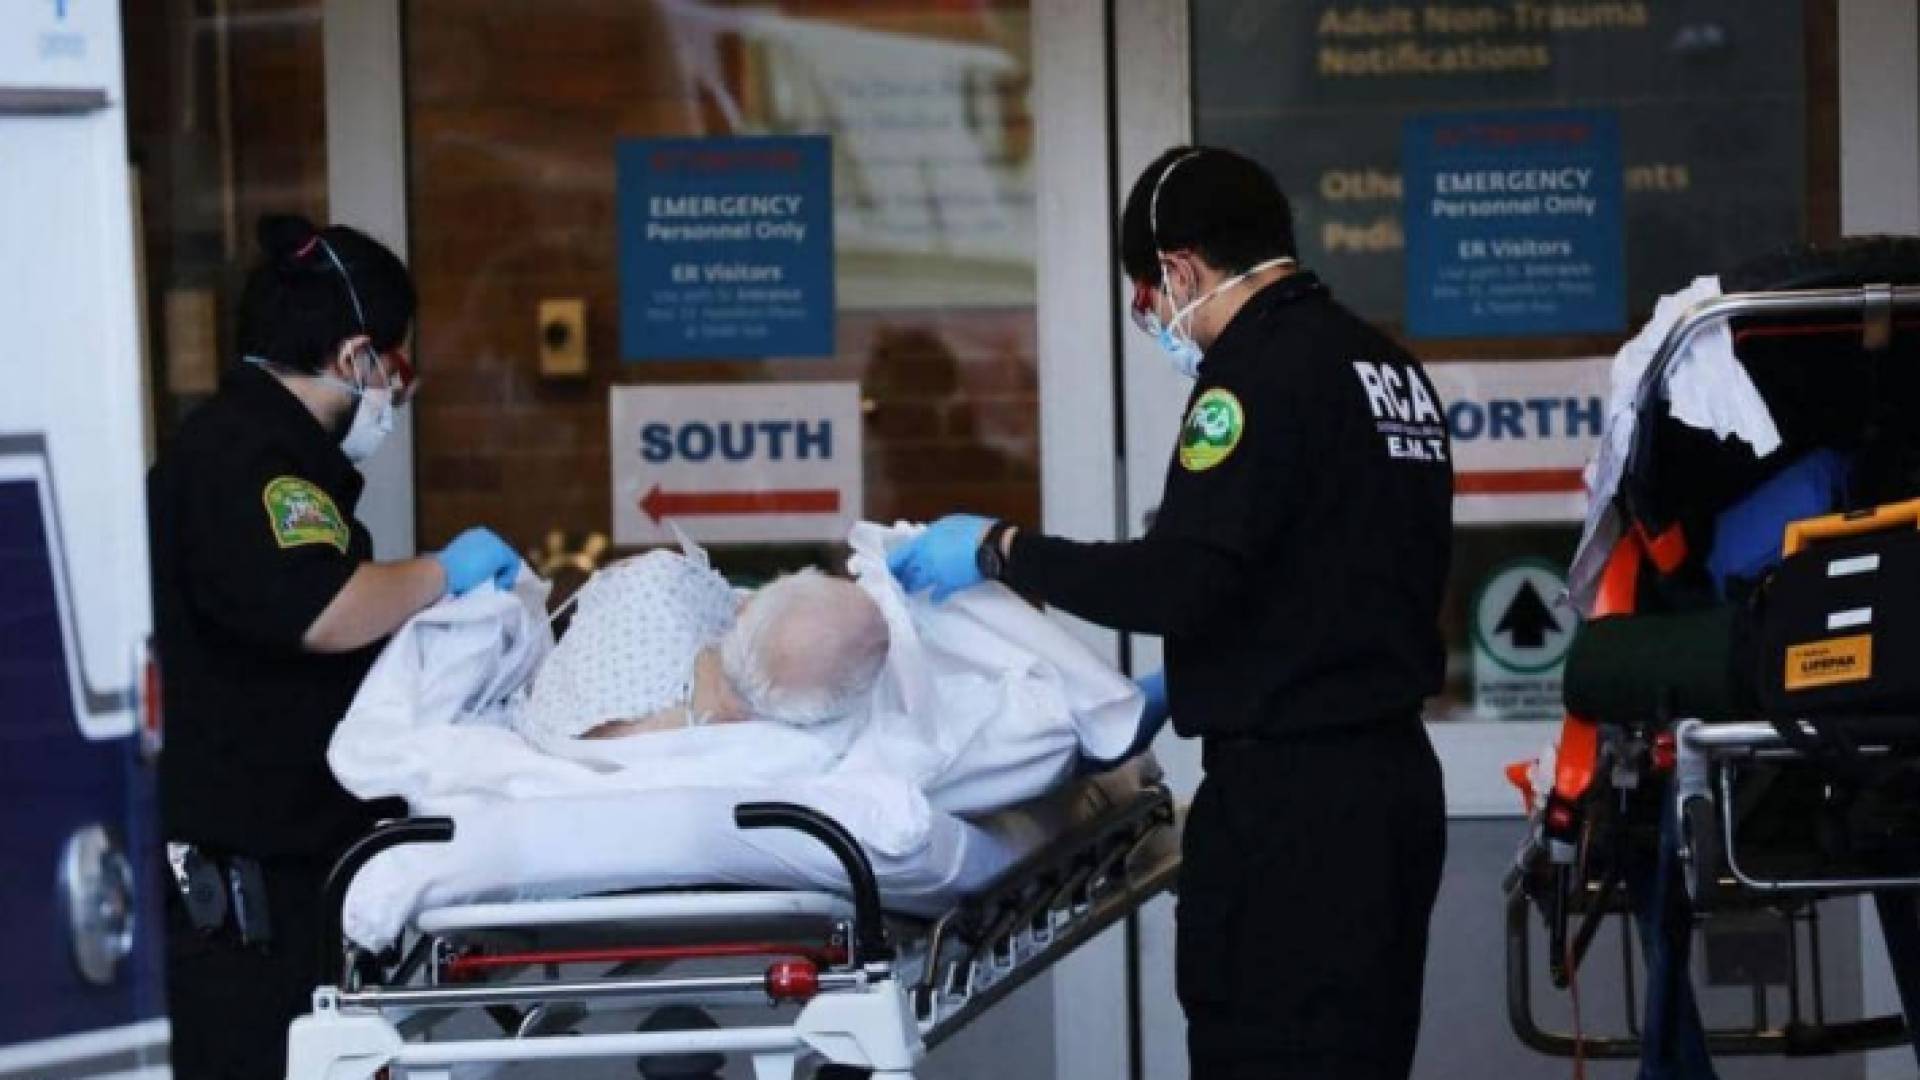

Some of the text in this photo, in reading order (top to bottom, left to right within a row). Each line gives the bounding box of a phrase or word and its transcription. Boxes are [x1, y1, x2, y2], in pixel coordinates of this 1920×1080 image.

[1317, 5, 1413, 34] Adult
[1318, 39, 1550, 74] Notifications
[1436, 168, 1591, 192] EMERGENCY
[648, 196, 803, 217] EMERGENCY
[1432, 194, 1597, 218] Personnel Only
[646, 220, 807, 244] Personnel Only
[1458, 237, 1572, 259] ER Visitors
[671, 262, 784, 283] ER Visitors
[1352, 361, 1440, 422] RCA
[1444, 396, 1603, 441] ORTH
[640, 420, 833, 464] SOUTH
